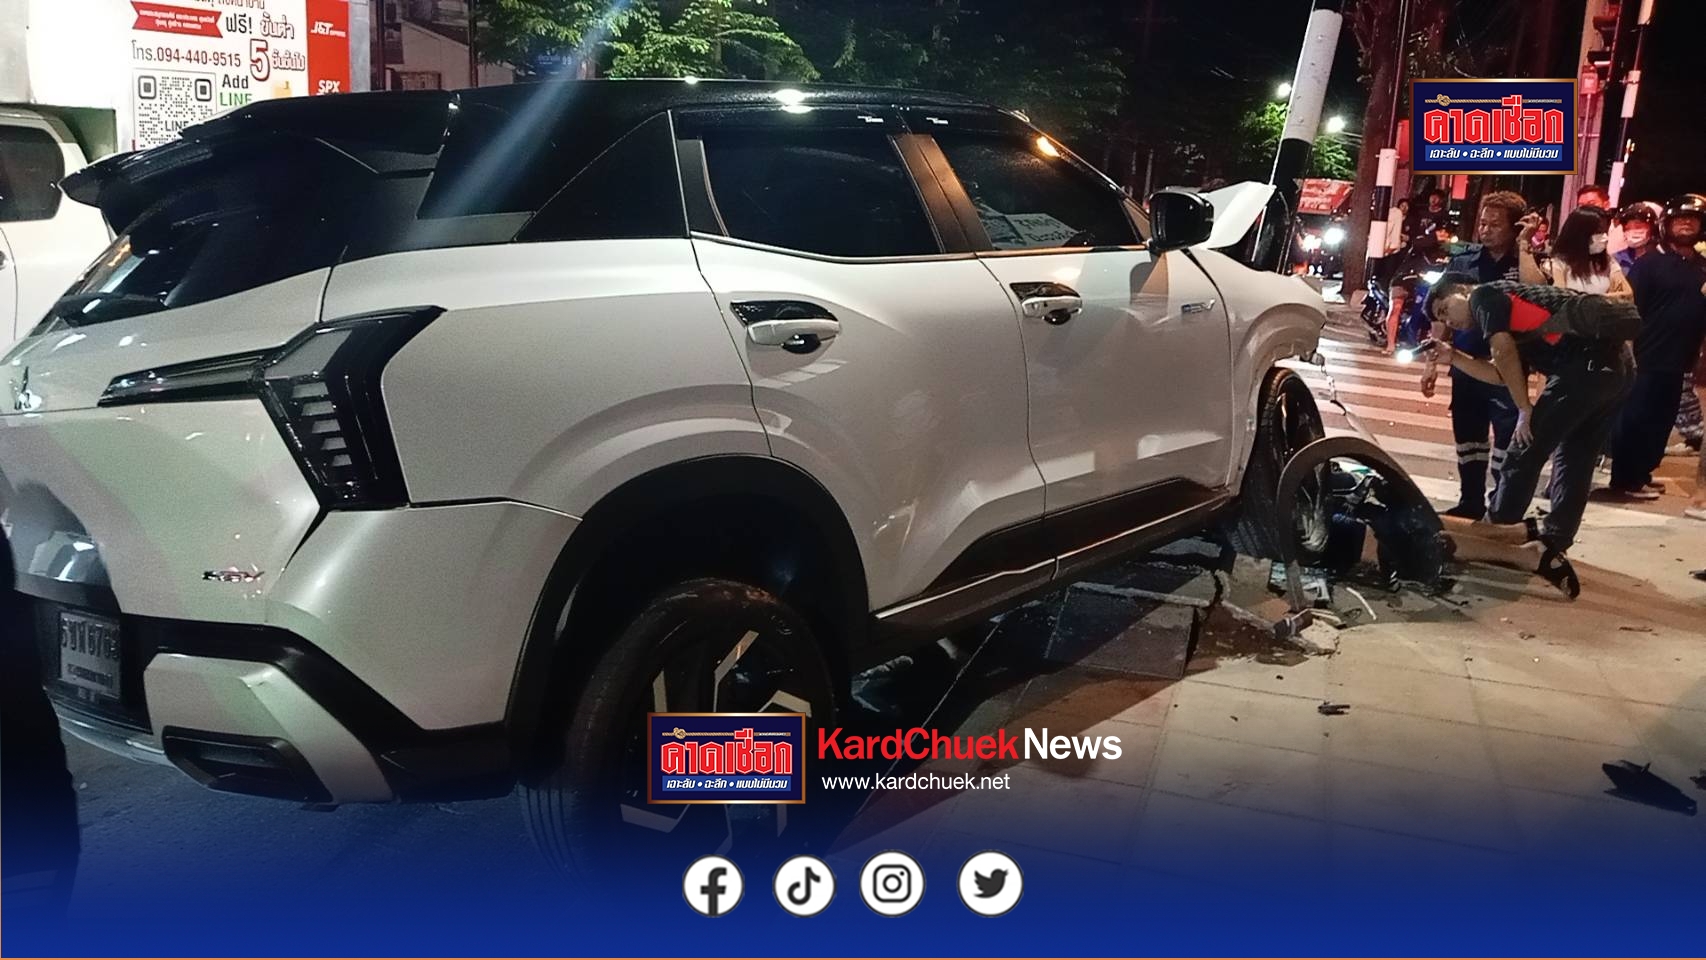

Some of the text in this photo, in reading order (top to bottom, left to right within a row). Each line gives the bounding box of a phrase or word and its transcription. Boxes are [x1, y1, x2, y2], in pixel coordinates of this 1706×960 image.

[226, 13, 252, 34] ฟรี!
[249, 38, 271, 81] 5
[222, 74, 249, 89] Add
[318, 79, 341, 94] SPX
